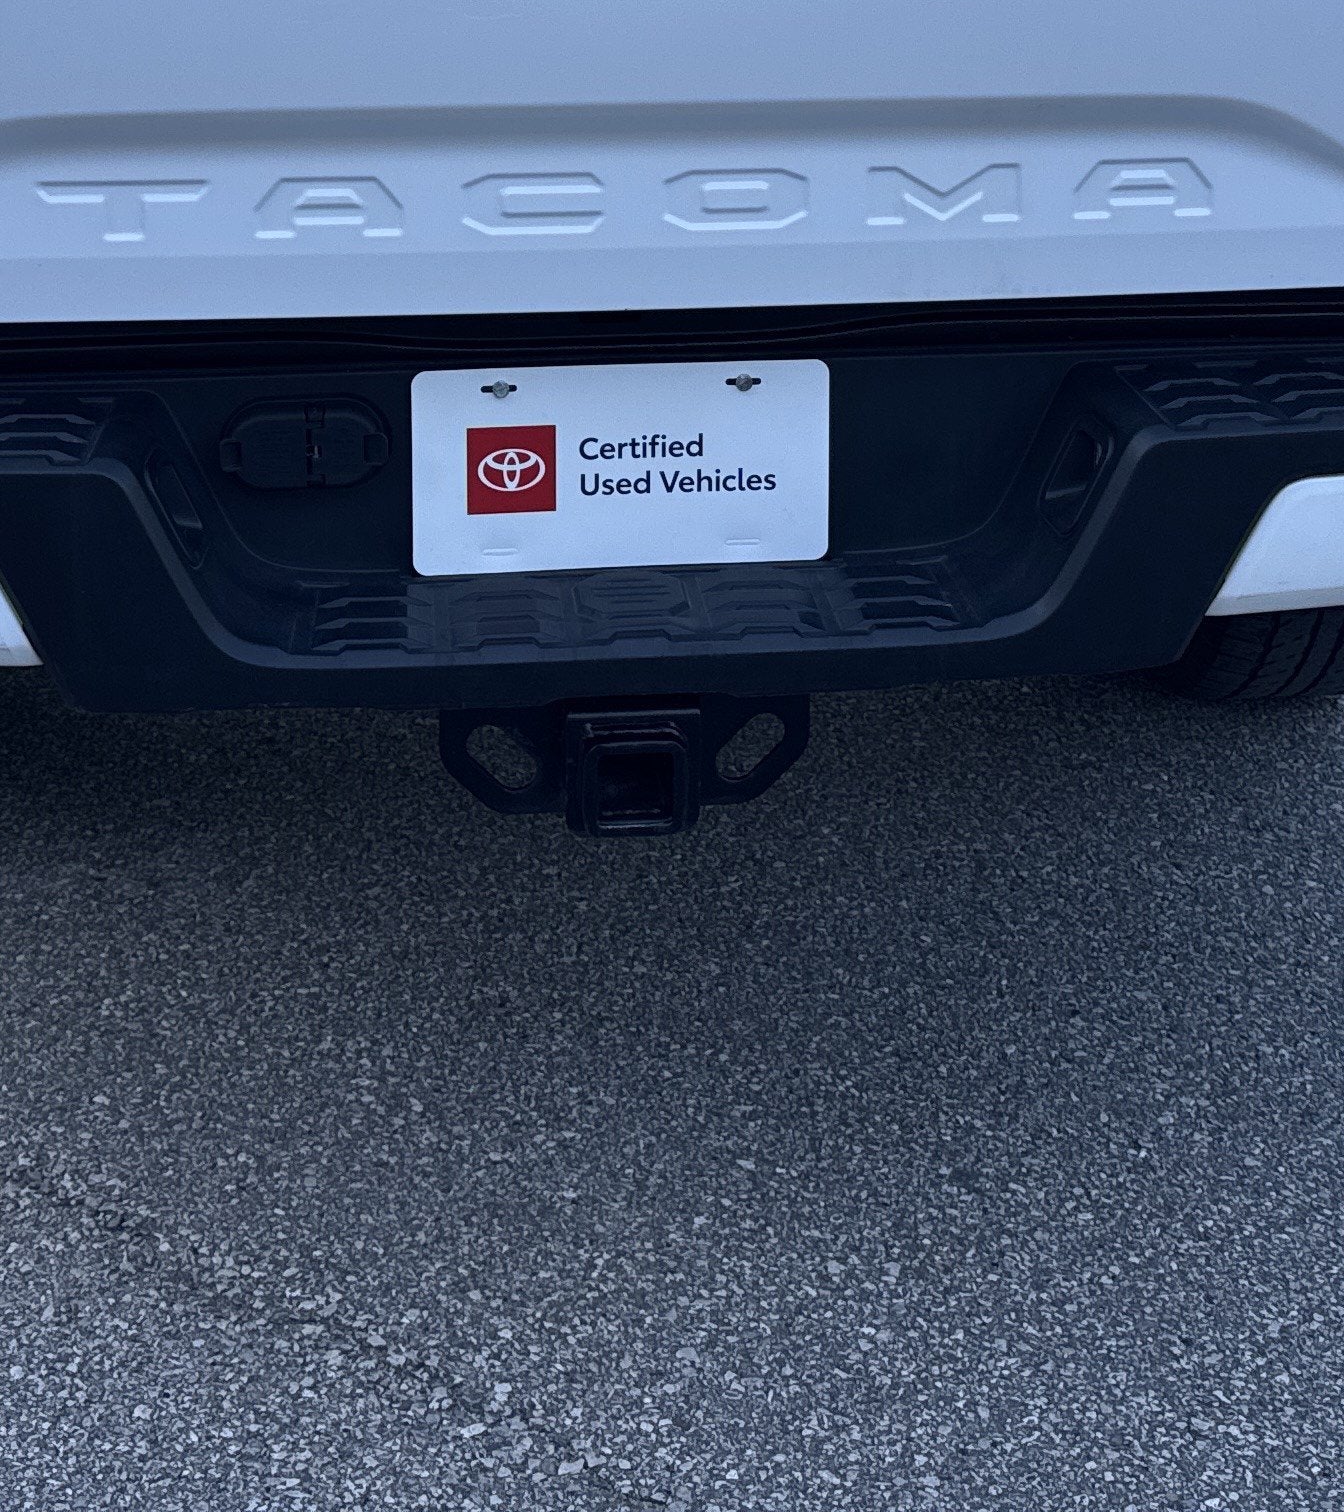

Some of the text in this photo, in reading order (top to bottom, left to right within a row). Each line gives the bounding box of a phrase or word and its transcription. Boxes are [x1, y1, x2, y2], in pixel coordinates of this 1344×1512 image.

[36, 157, 1214, 243] TACOMA
[579, 433, 704, 460] Certified
[580, 468, 777, 496] Used Vehicles
